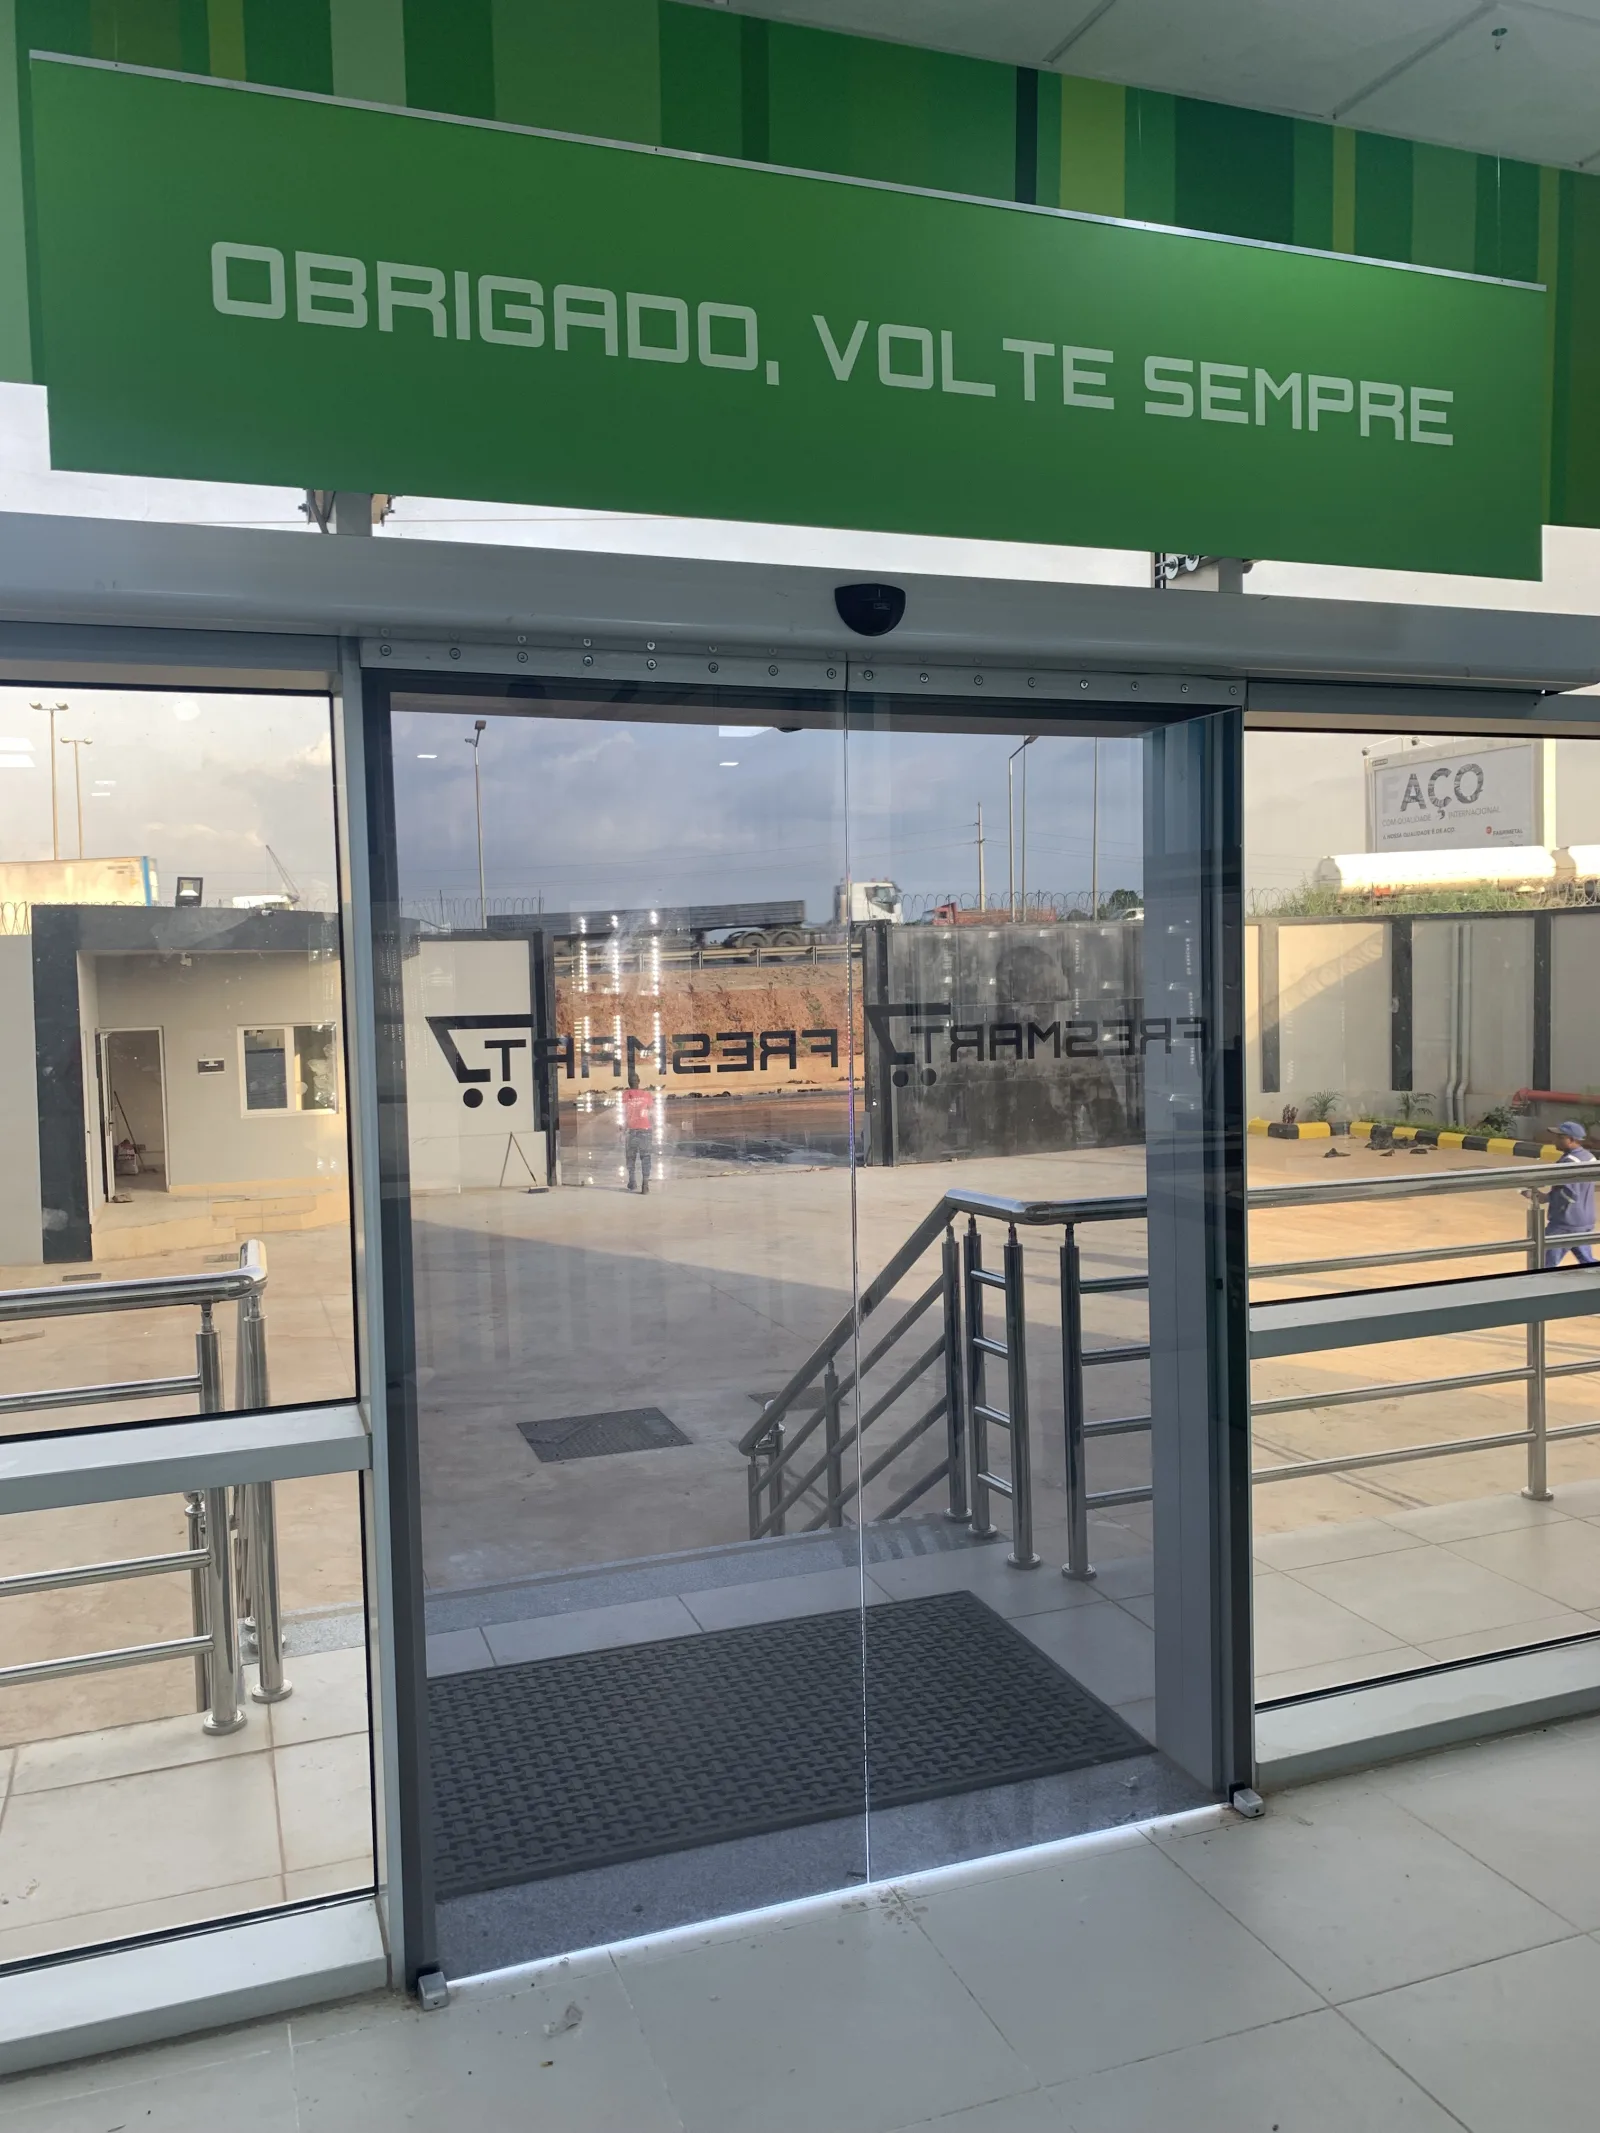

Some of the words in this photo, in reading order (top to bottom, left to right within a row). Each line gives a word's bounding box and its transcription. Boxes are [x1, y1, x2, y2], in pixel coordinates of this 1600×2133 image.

[210, 241, 780, 387] OBRIGADO,
[812, 314, 1115, 411] VOLTE
[1144, 355, 1455, 447] SEMPRE
